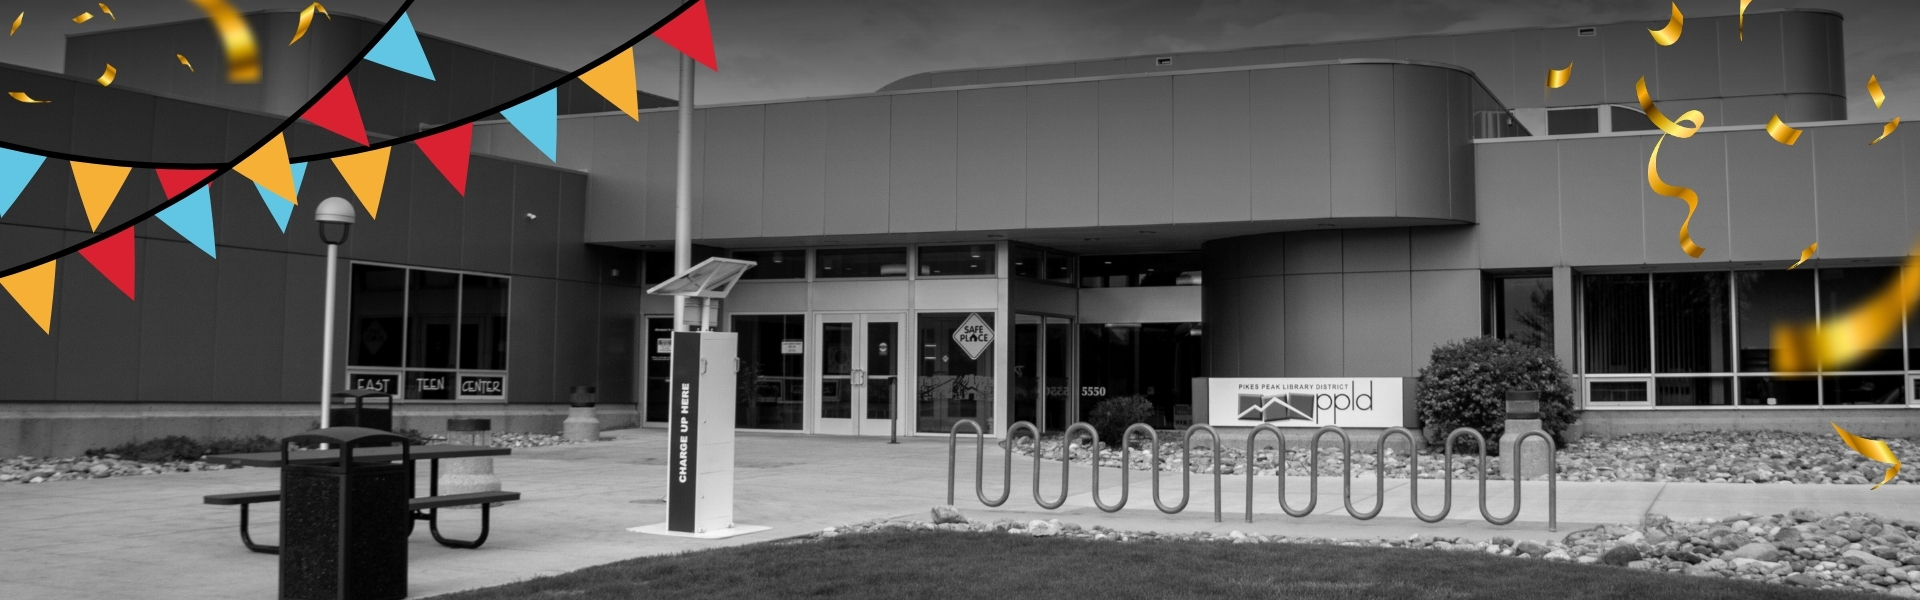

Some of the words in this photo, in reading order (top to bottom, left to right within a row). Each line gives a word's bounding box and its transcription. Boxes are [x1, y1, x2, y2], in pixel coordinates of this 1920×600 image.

[964, 325, 983, 334] SAFE
[357, 378, 390, 392] EAST
[416, 376, 444, 392] TEEN
[462, 379, 501, 394] CENTER
[1081, 387, 1106, 396] 5550
[681, 382, 690, 414] HERE
[1316, 380, 1373, 425] ppld
[680, 417, 689, 433] UP
[678, 435, 688, 483] CHARGE
